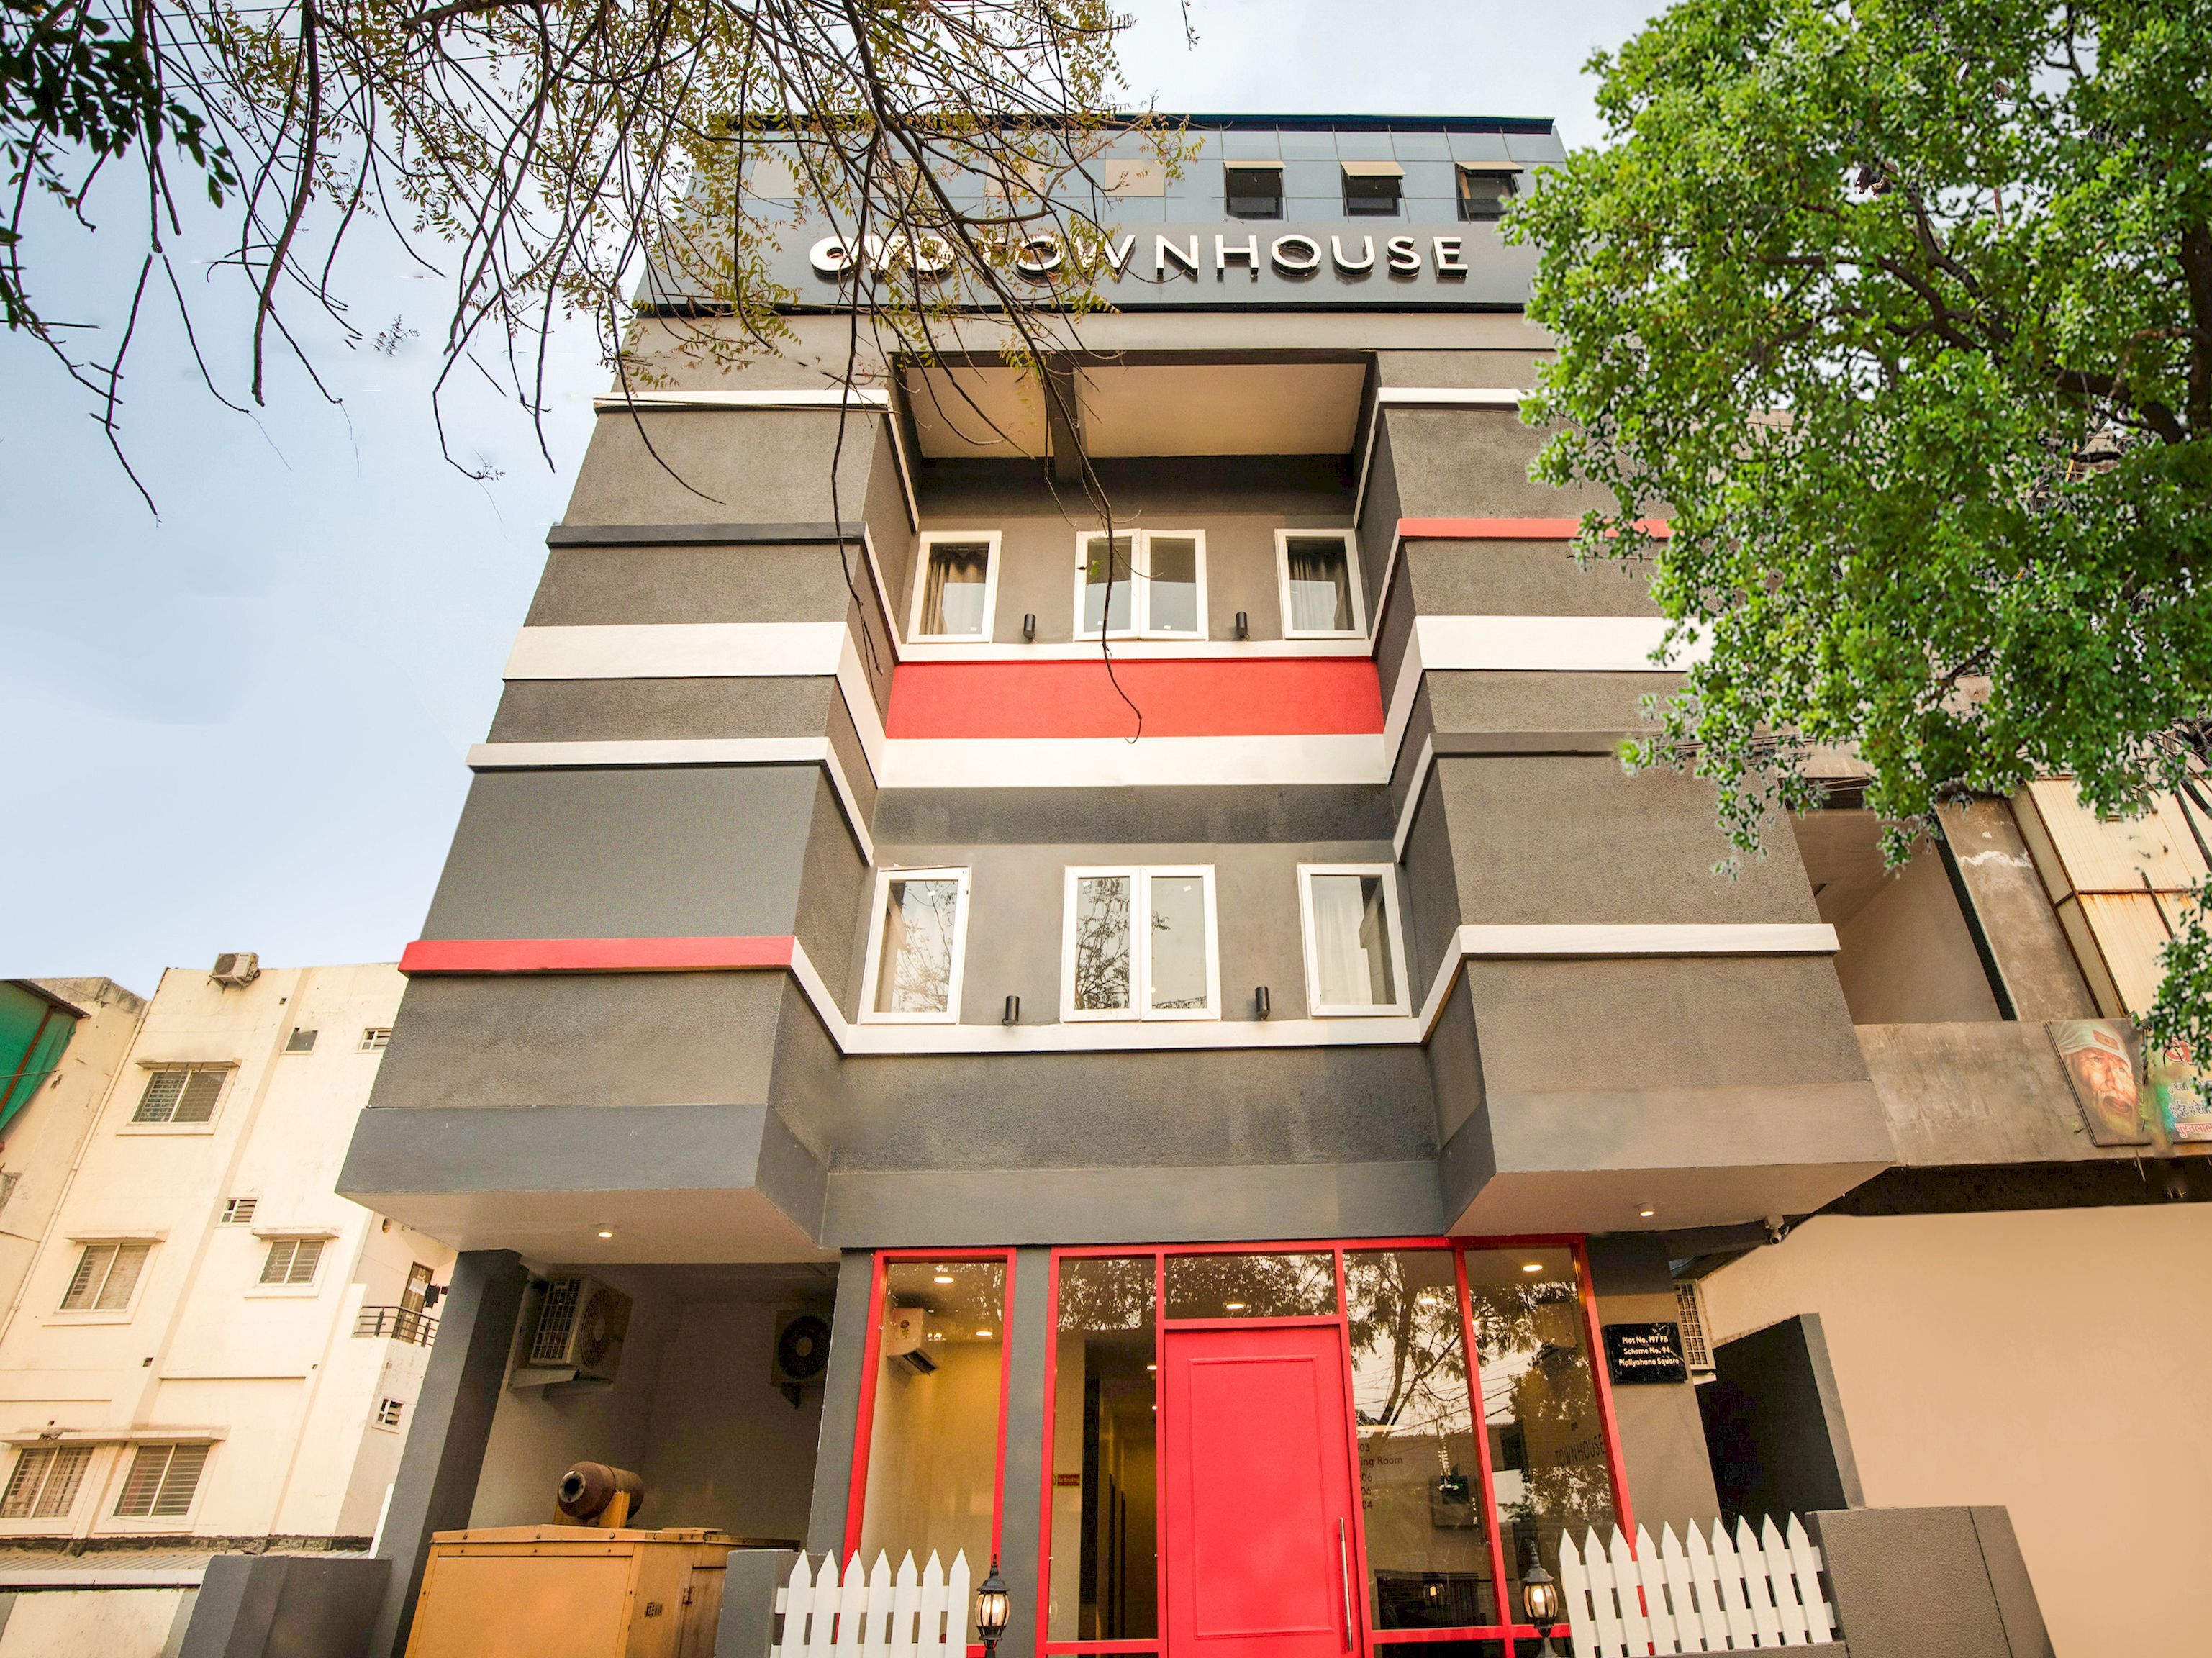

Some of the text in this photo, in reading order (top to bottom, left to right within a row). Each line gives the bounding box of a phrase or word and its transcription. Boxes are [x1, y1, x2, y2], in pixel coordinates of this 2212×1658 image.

[969, 234, 1469, 276] TOWNHOUSE
[1657, 1357, 1680, 1366] Square
[1359, 1443, 1370, 1452] 03
[1555, 1433, 1605, 1467] TOWNHOUSE
[1359, 1456, 1403, 1468] ing Room
[1361, 1473, 1372, 1482] 06
